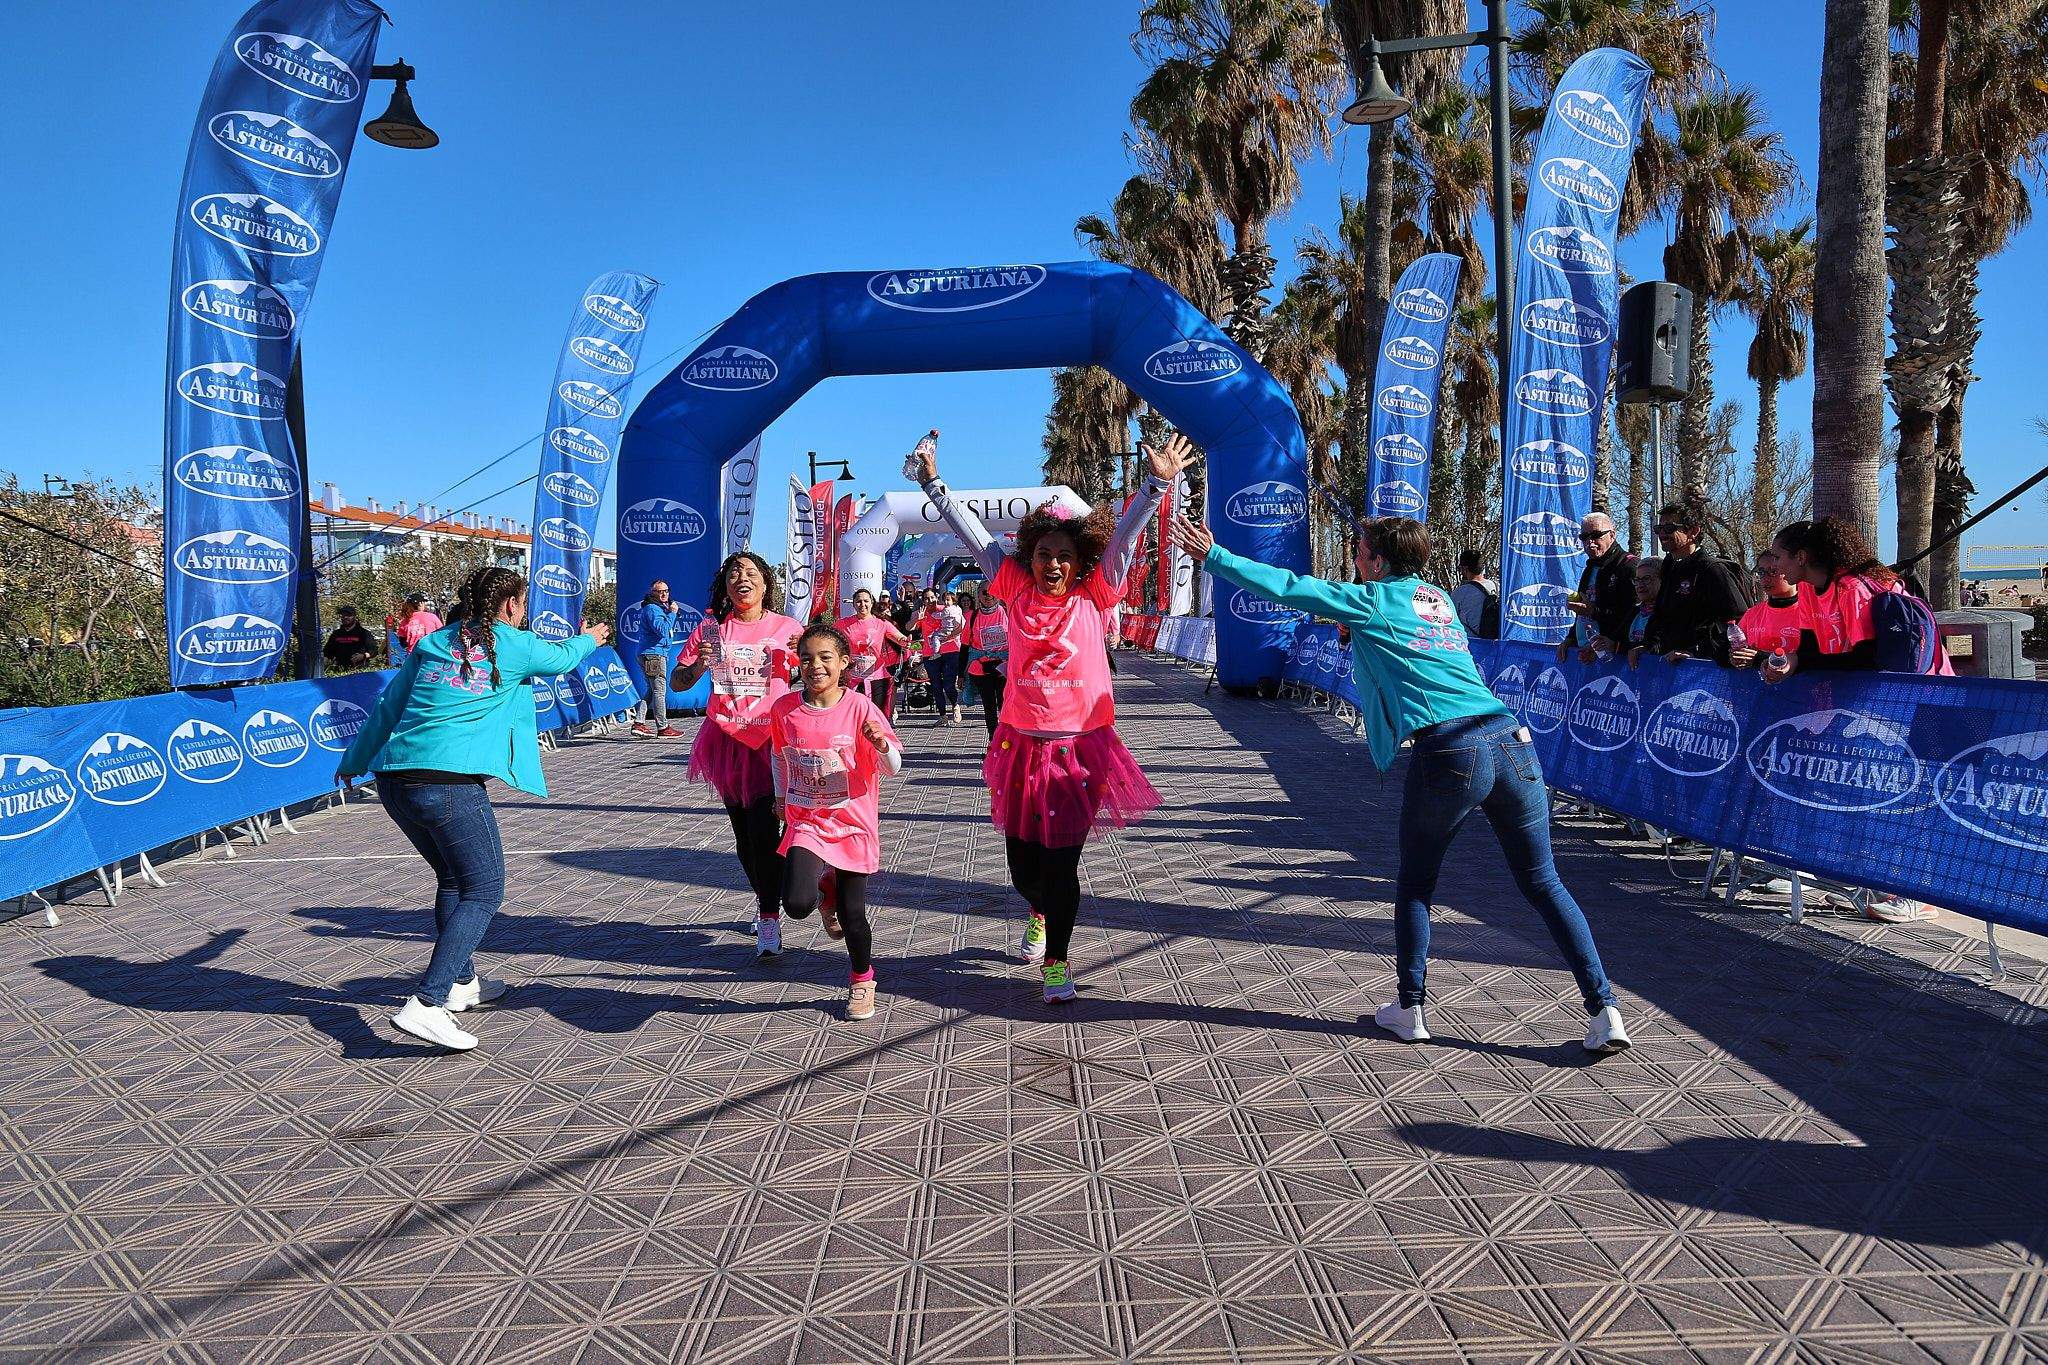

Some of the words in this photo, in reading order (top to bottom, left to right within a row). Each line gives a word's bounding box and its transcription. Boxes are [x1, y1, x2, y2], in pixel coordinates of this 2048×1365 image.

[243, 40, 351, 99] ASTURIANA
[242, 122, 285, 142] CENTRAL
[1561, 97, 1624, 145] ASTURIANA
[218, 119, 330, 175] ASTURIANA
[1545, 165, 1612, 208] ASTURIANA
[201, 202, 309, 252] ASTURIANA
[1533, 235, 1610, 271] ASTURIANA
[880, 271, 1034, 297] ASTURIANA
[192, 290, 289, 331] ASTURIAN
[1524, 309, 1602, 340] ASTURIANA
[574, 340, 630, 373] ASTURIANA
[1152, 358, 1237, 376] ASTURIANA
[1389, 344, 1434, 366] ASTURIANA
[686, 364, 770, 380] ASTURIANA
[187, 375, 285, 410] ASTURIAN
[1382, 392, 1428, 413] ASTURIANA
[1519, 381, 1590, 410] ASTURIANA
[185, 460, 293, 494] ASTURIANA
[204, 461, 246, 472] CENTRAL
[1514, 453, 1586, 479] ASTURIANA
[920, 497, 1031, 522] OSHO
[624, 516, 701, 535] ASTURIANA
[815, 497, 826, 559] Santander
[856, 527, 890, 535] OYSHO
[184, 547, 288, 572] ASTURIANA
[203, 546, 245, 555] CENTRAL
[789, 491, 814, 601] OYSHO
[843, 571, 874, 580] OYSHO
[186, 633, 277, 656] ASTURIANA
[1571, 697, 1632, 738] ASTURIANA
[249, 732, 306, 757] ASTURIANA
[1647, 713, 1729, 761] ASTURIANA
[1787, 736, 1838, 754] CENTRAL
[175, 745, 240, 772] ASTURIANA
[1756, 736, 1901, 794] ASTURIANA
[86, 759, 163, 794] ASTURIANA
